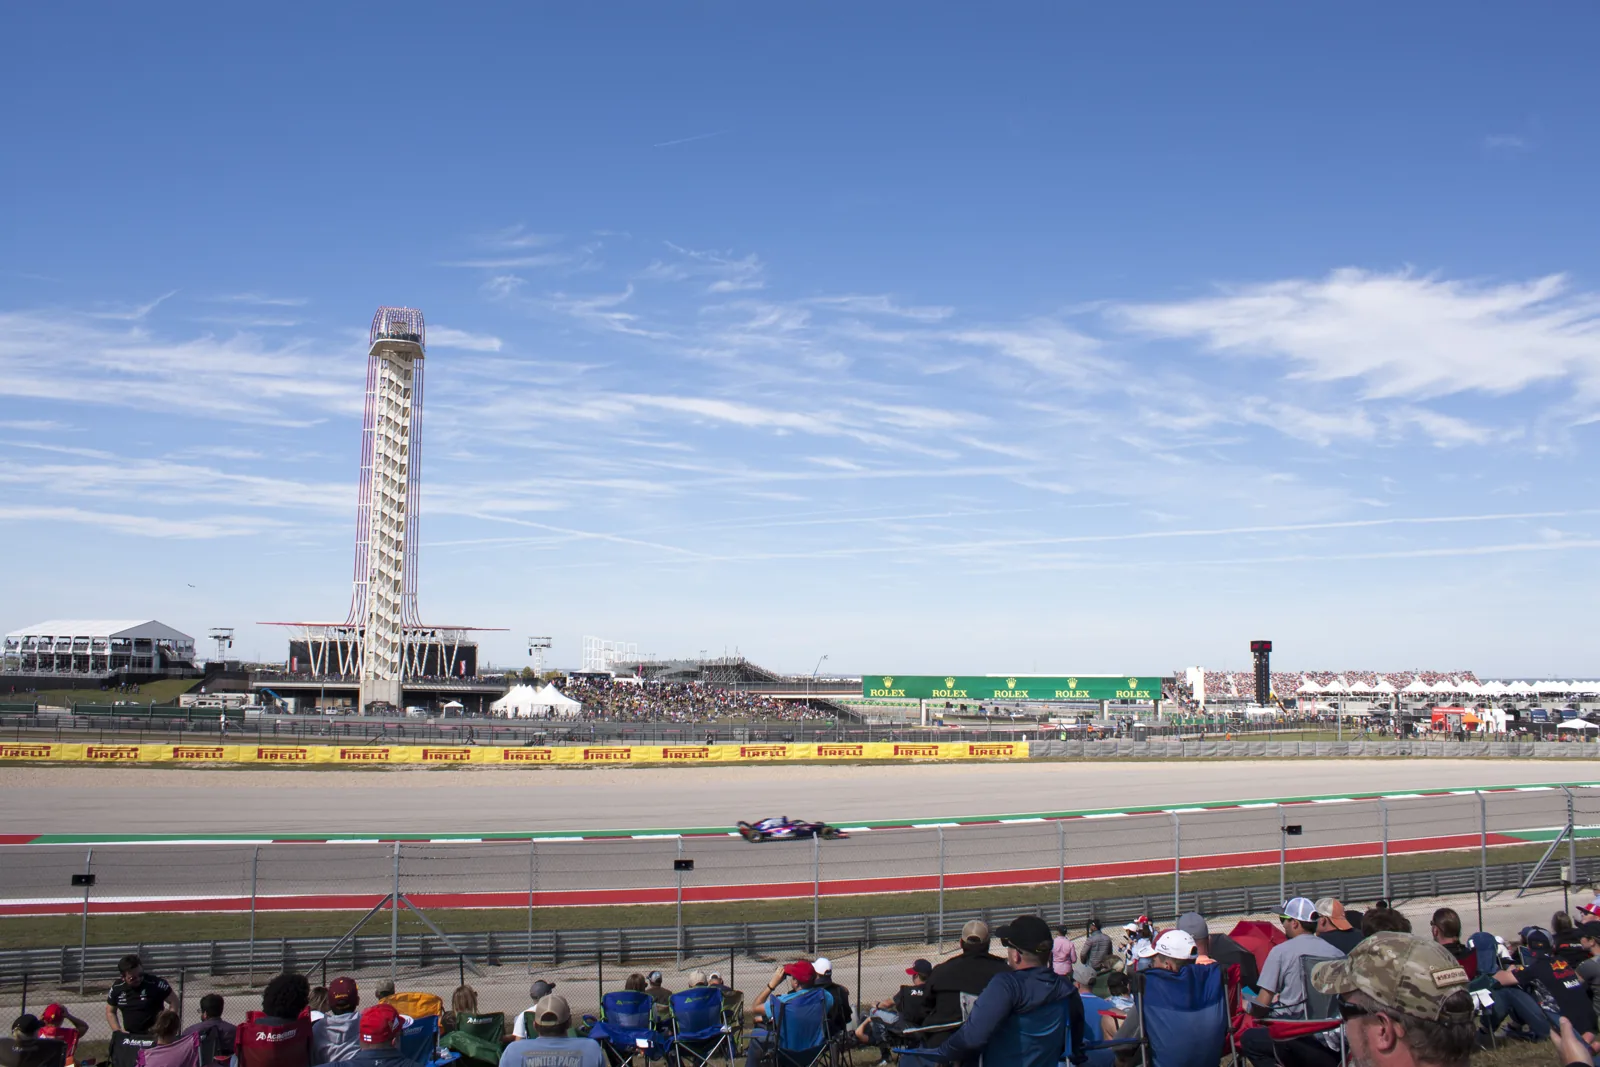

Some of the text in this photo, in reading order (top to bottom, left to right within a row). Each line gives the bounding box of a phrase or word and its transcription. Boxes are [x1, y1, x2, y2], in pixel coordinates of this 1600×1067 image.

[870, 689, 905, 697] ROLEX
[932, 690, 967, 698] ROLEX
[994, 690, 1029, 698] ROLEX
[1055, 690, 1090, 698] ROLEX
[1116, 690, 1150, 698] ROLEX
[87, 747, 139, 758] PIRELLI
[173, 747, 224, 758] PIRELLI
[258, 748, 307, 759] PIRELLI
[340, 749, 389, 760] PIRELLI
[423, 749, 471, 760] PIRELLI
[503, 749, 551, 761] PIRELLI
[583, 749, 631, 760] PIRELLI
[663, 748, 709, 759] PIRELLI
[741, 747, 786, 758] PIRELLI
[818, 746, 863, 757] PIRELLI
[894, 745, 939, 756] PIRELLI
[969, 745, 1014, 755] PIRELLI
[526, 1056, 580, 1067] WINTER PARK
